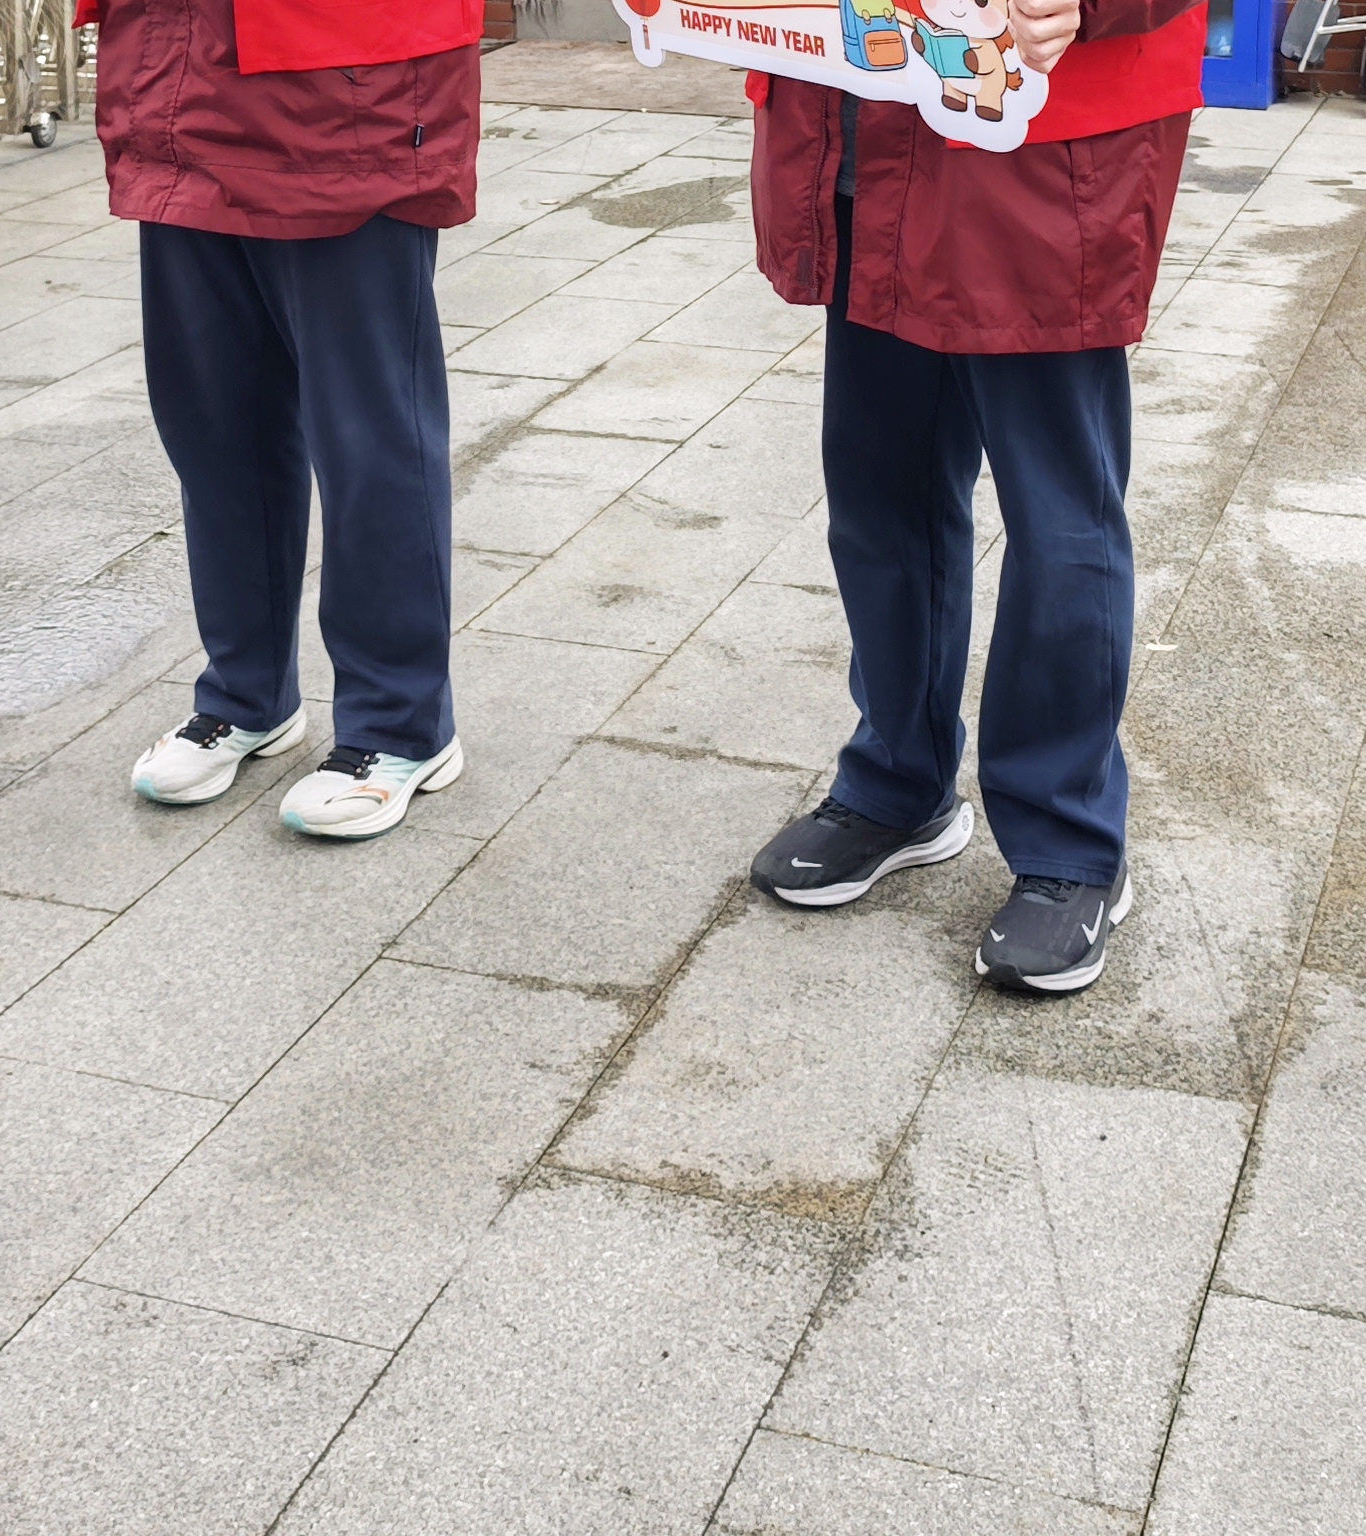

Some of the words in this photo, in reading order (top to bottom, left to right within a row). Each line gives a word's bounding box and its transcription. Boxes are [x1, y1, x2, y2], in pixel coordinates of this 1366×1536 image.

[680, 8, 733, 38] HAPPY
[737, 20, 777, 46] NEW
[781, 29, 825, 57] YEAR
